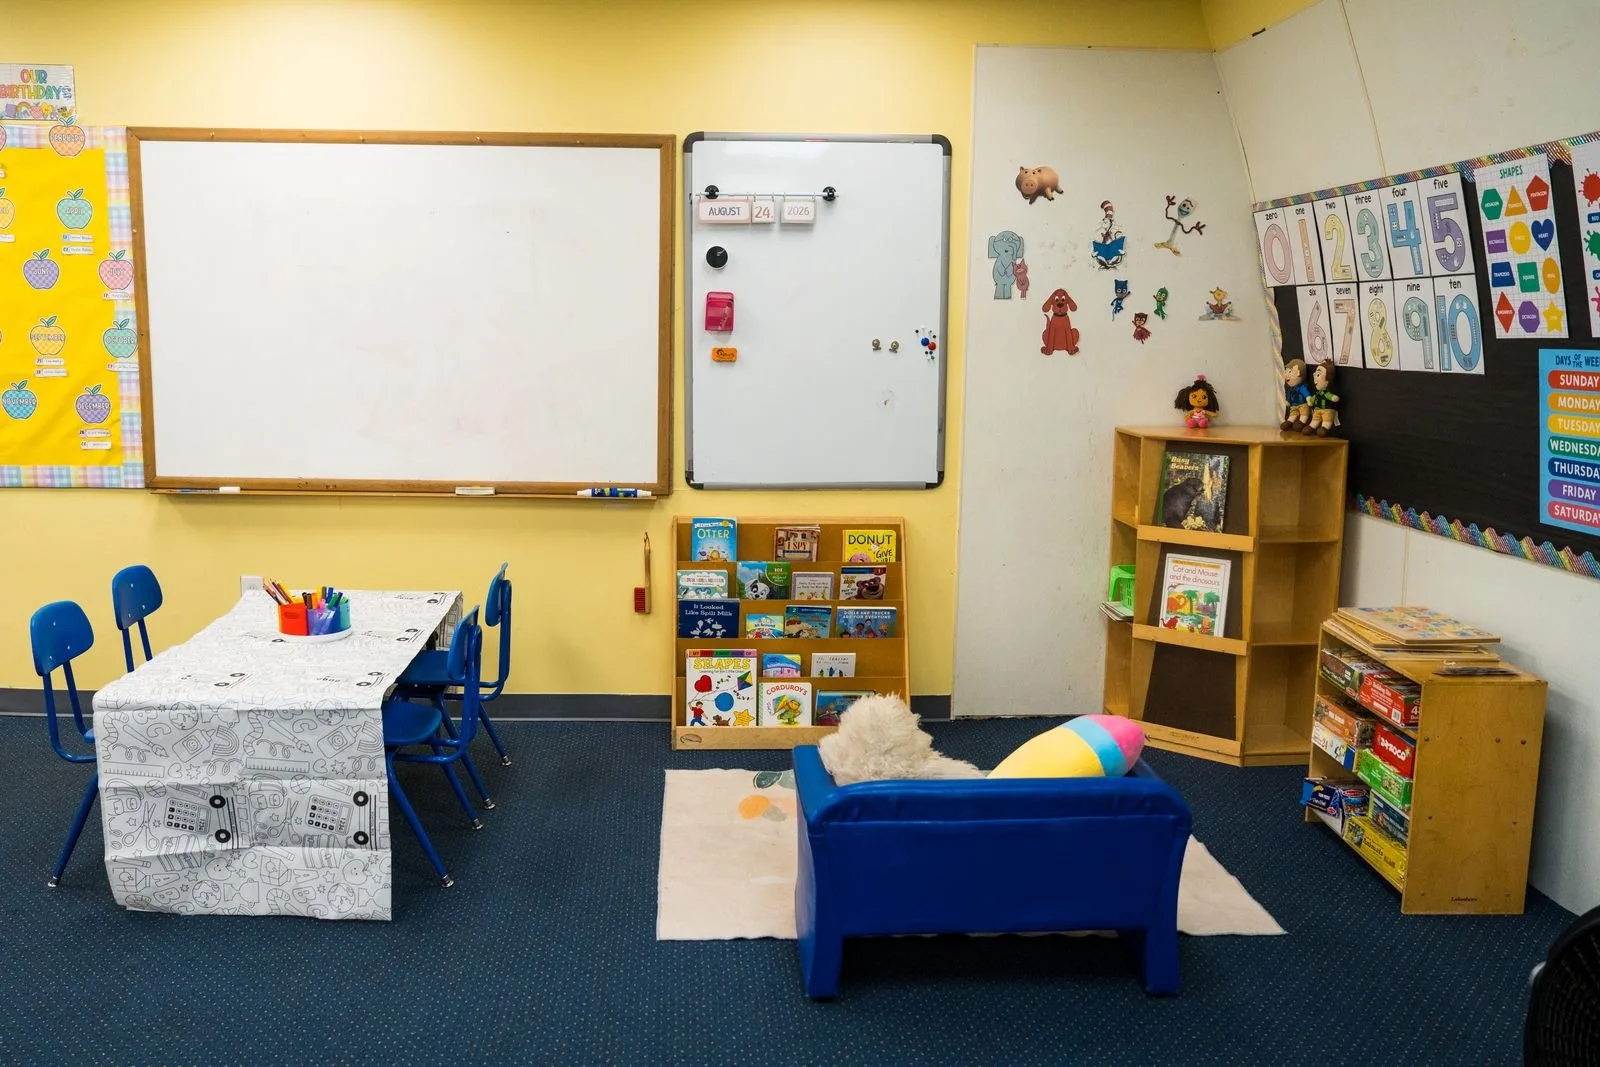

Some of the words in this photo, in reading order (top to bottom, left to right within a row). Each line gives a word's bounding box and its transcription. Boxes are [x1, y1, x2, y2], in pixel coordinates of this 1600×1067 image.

[20, 69, 48, 84] OUR
[1499, 165, 1523, 180] SHAPES
[1433, 178, 1449, 190] five
[1392, 187, 1407, 198] four
[1355, 194, 1372, 204] three
[708, 206, 741, 216] AUGUST
[787, 206, 810, 216] 2026
[1295, 207, 1305, 215] one
[1325, 201, 1336, 210] two
[1265, 212, 1278, 220] zero
[1387, 200, 1423, 275] 4
[1427, 192, 1465, 272] 5
[1324, 213, 1352, 280] 2
[1356, 208, 1384, 278] 3
[1263, 223, 1291, 284] 0
[1298, 218, 1315, 282] 1
[1369, 284, 1384, 296] eight
[1406, 282, 1421, 292] nine
[1449, 279, 1462, 289] ten
[1308, 288, 1317, 296] six
[1336, 287, 1352, 295] seven
[1307, 300, 1328, 363] 6
[1334, 299, 1355, 364] 7
[1368, 298, 1393, 368] 8
[1403, 296, 1434, 370] 9
[1436, 294, 1482, 371] 10
[1555, 355, 1571, 366] DAYS
[1573, 353, 1581, 361] OF
[1584, 355, 1600, 368] WEE
[1560, 374, 1600, 388] SUNDAY
[78, 402, 110, 410] DECEMBER
[1558, 396, 1600, 411] MONDAY
[1558, 418, 1600, 433] TUESDAY
[1550, 439, 1600, 457] WEDNESDA
[1170, 462, 1199, 471] Beavers
[1171, 456, 1190, 465] Busy
[1554, 461, 1600, 480] THURSDA
[1562, 484, 1597, 501] FRIDAY
[1554, 505, 1600, 524] SATURDA
[697, 528, 730, 540] OTTER
[848, 534, 893, 545] DONUT
[787, 541, 791, 549] I
[792, 541, 808, 550] SPY
[1172, 565, 1184, 573] Cat
[1184, 567, 1197, 575] and
[1198, 569, 1219, 577] Mouse
[1192, 577, 1220, 586] dinosaurs
[693, 658, 752, 670] SHAPES
[766, 684, 808, 696] CORDUROY'S
